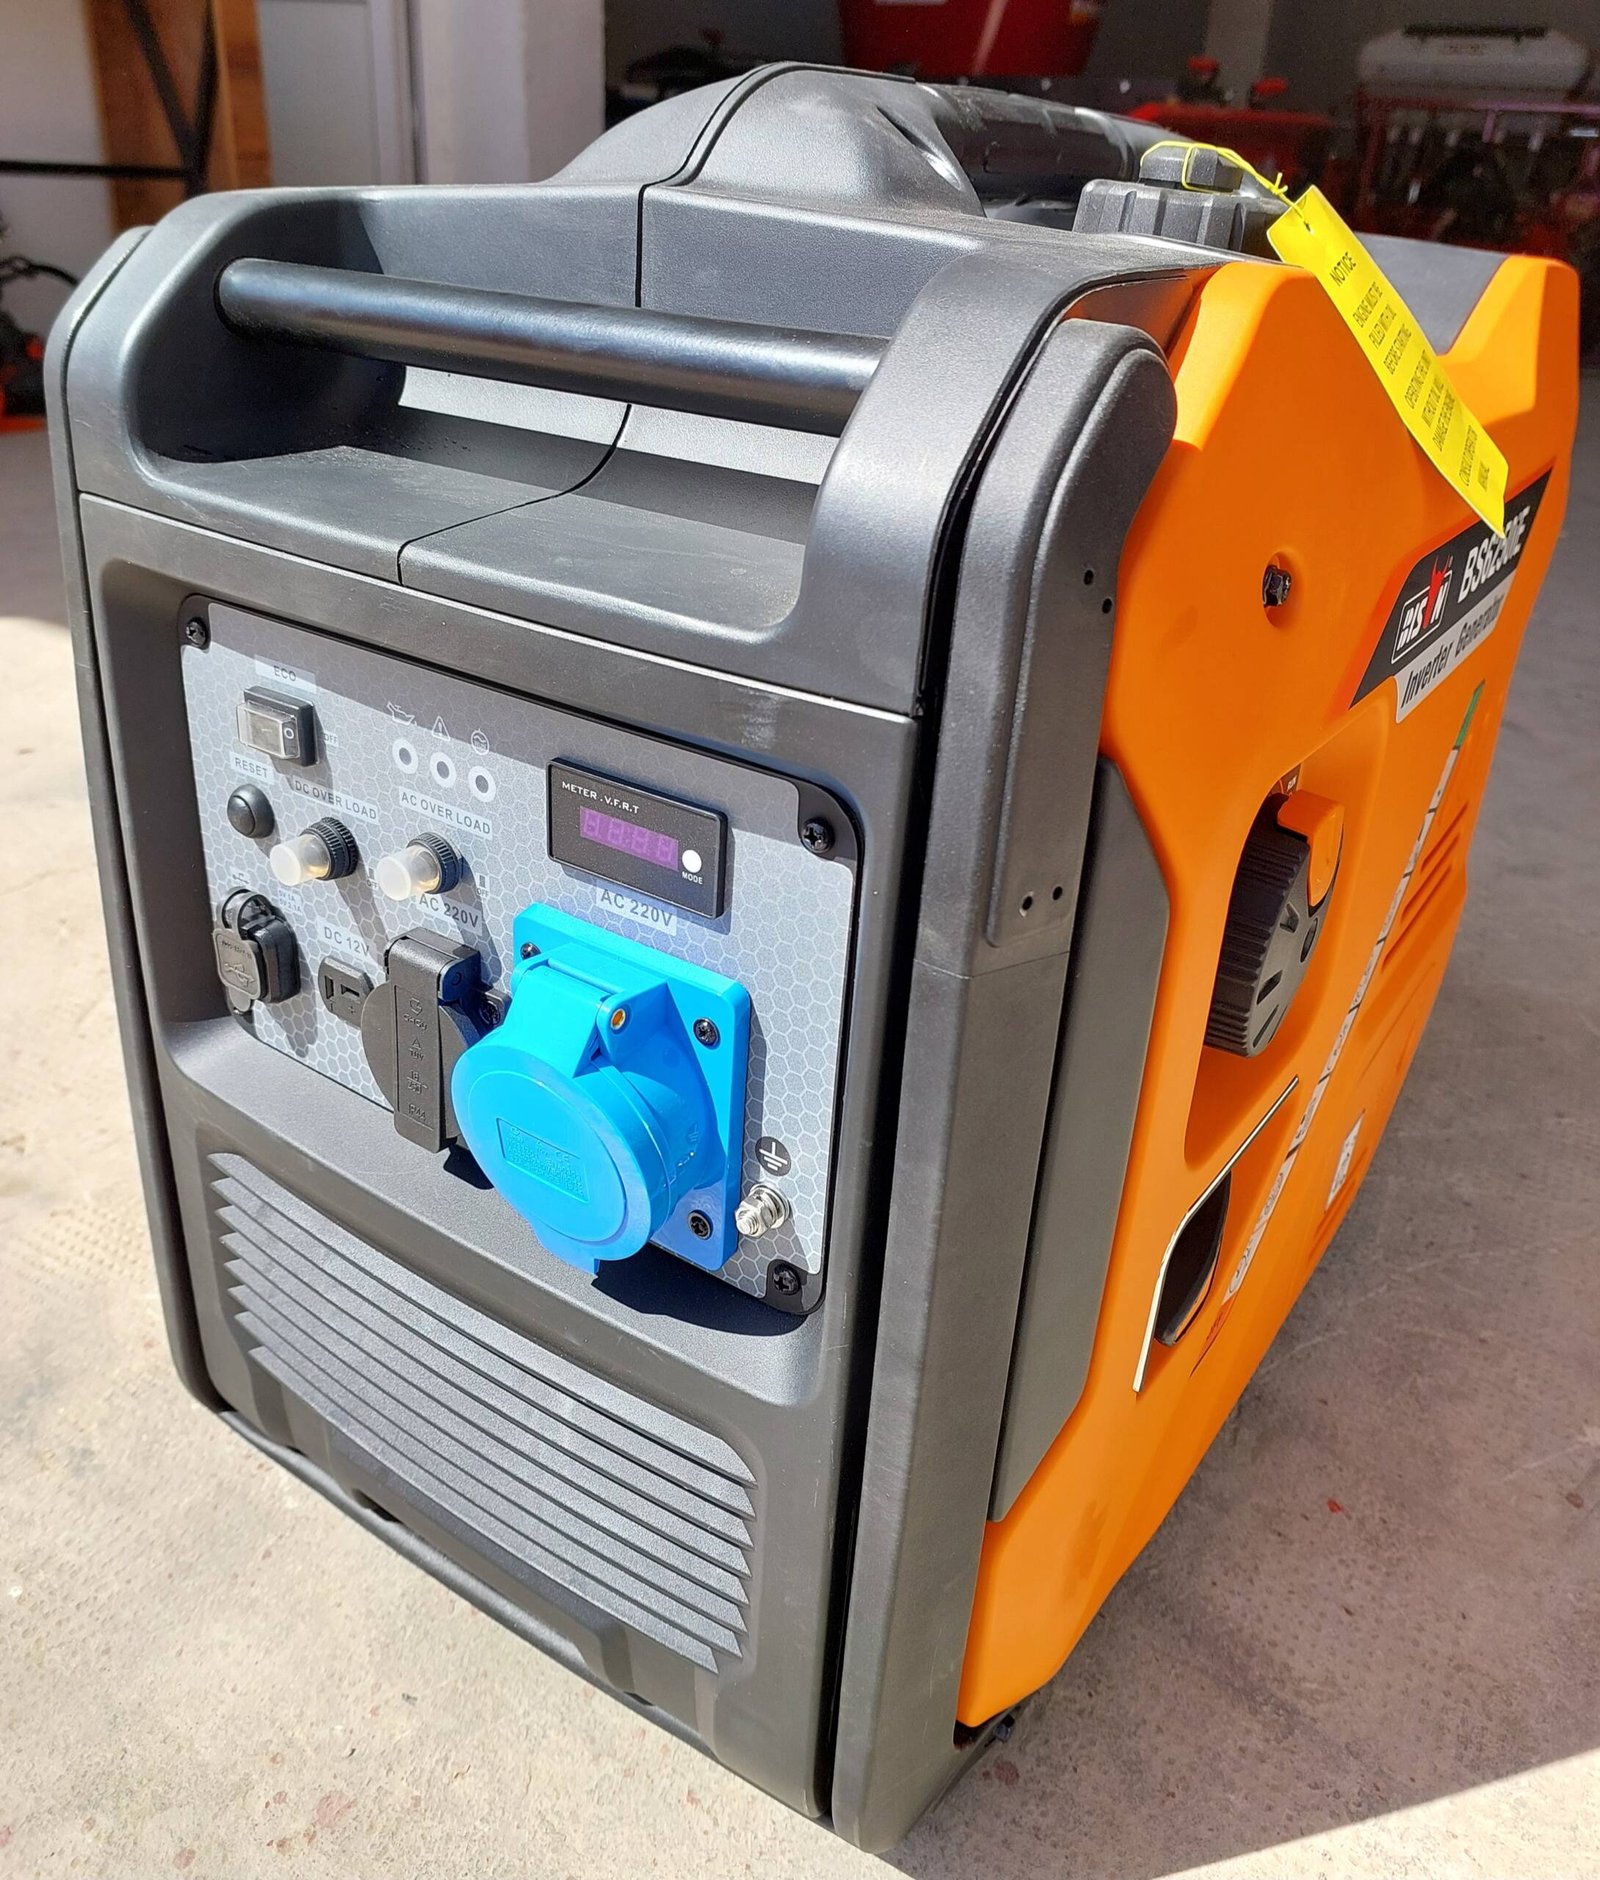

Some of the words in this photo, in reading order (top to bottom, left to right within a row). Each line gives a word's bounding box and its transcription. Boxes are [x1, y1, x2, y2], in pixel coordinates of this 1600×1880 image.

[1329, 251, 1357, 287] NOTICE
[273, 665, 297, 682] ECO
[1401, 640, 1455, 708] Inverter
[324, 732, 338, 744] OFF
[235, 757, 268, 777] RESET
[295, 779, 310, 795] DC
[312, 787, 343, 807] OVER
[345, 799, 377, 820] LOAD
[561, 781, 598, 800] METER
[401, 791, 417, 806] AC
[420, 799, 453, 821] OVER
[456, 813, 491, 835] LOAD
[367, 879, 378, 889] OFF
[681, 871, 703, 885] MODE
[477, 887, 489, 898] OFF
[419, 894, 440, 912] AC
[444, 902, 479, 928] 220V
[600, 889, 624, 909] AC
[630, 899, 673, 927] 220V
[324, 926, 342, 944] DC
[346, 938, 370, 956] 12V
